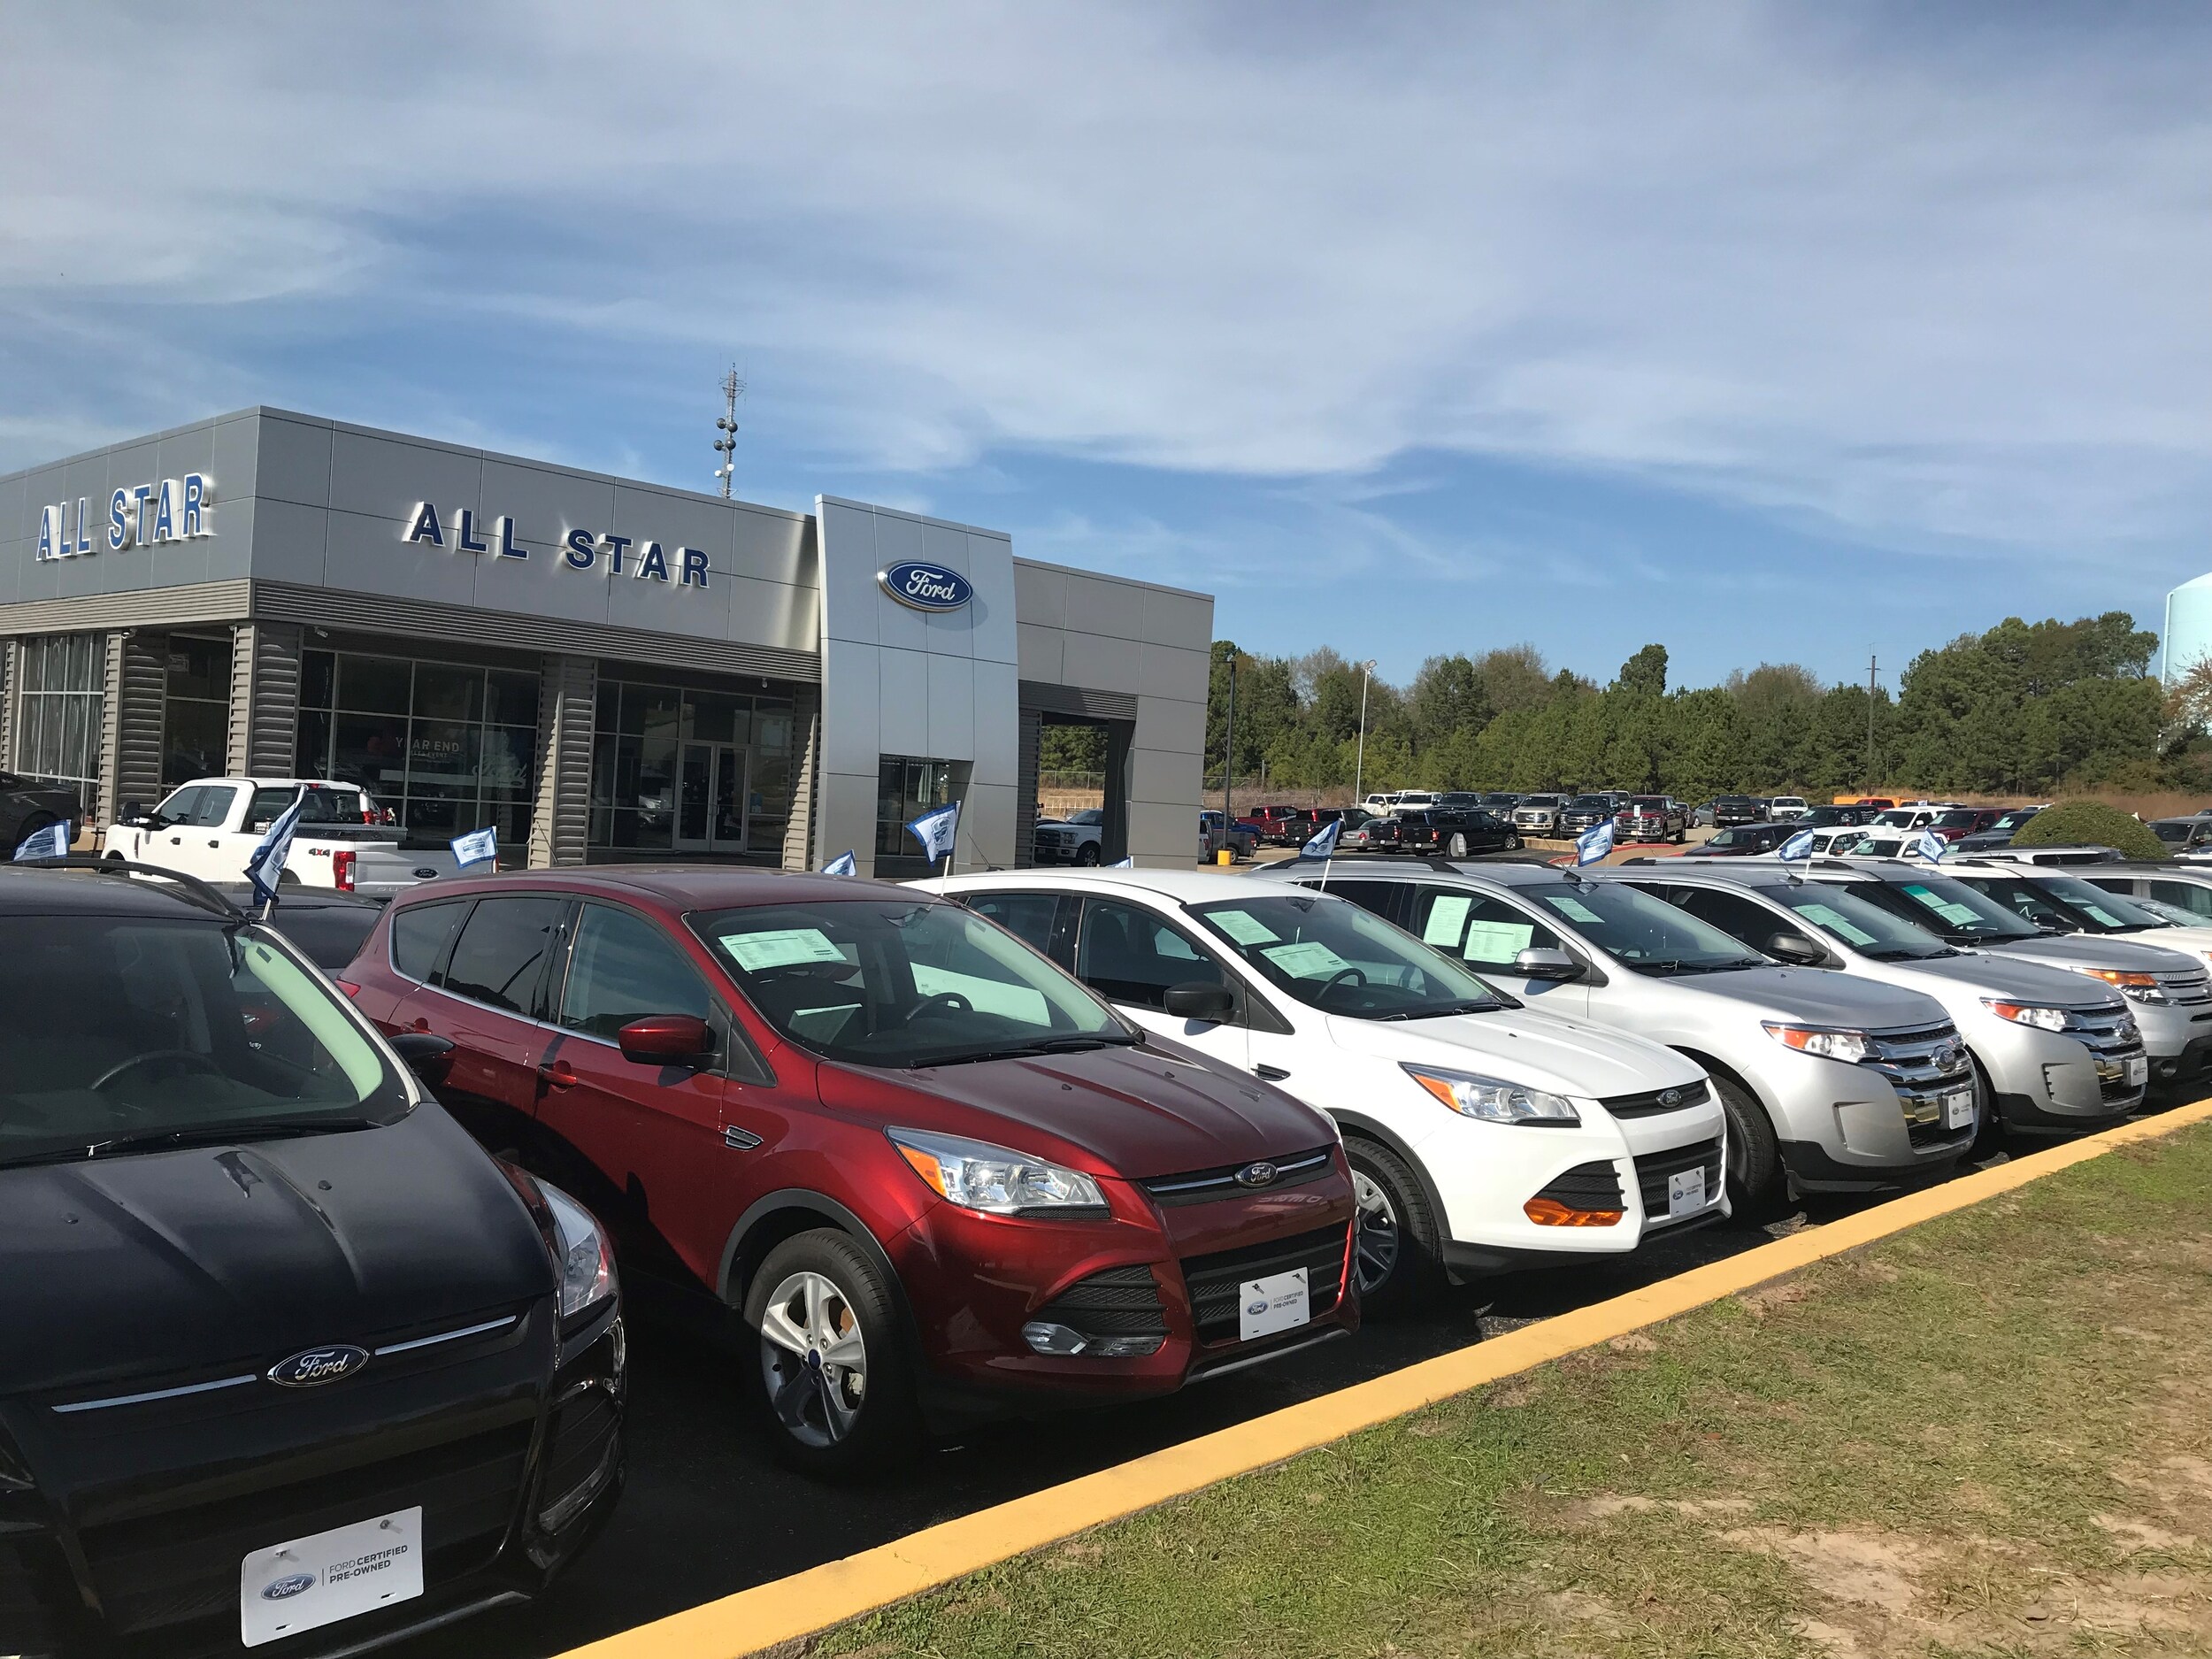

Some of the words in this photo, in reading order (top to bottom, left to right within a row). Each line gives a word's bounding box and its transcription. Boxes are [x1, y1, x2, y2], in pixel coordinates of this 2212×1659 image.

[36, 497, 92, 561] ALL
[108, 472, 204, 549] STAR
[407, 502, 529, 560] ALL
[565, 528, 710, 588] STAR
[906, 570, 956, 600] Ford
[396, 737, 430, 750] YAR
[434, 741, 460, 752] END
[1250, 1165, 1271, 1182] Ford
[294, 1351, 349, 1380] Ford
[329, 1560, 356, 1574] FORD
[357, 1545, 408, 1566] CERTIFIED
[329, 1560, 391, 1584] PRE-OWNED
[272, 1578, 305, 1597] Ford
